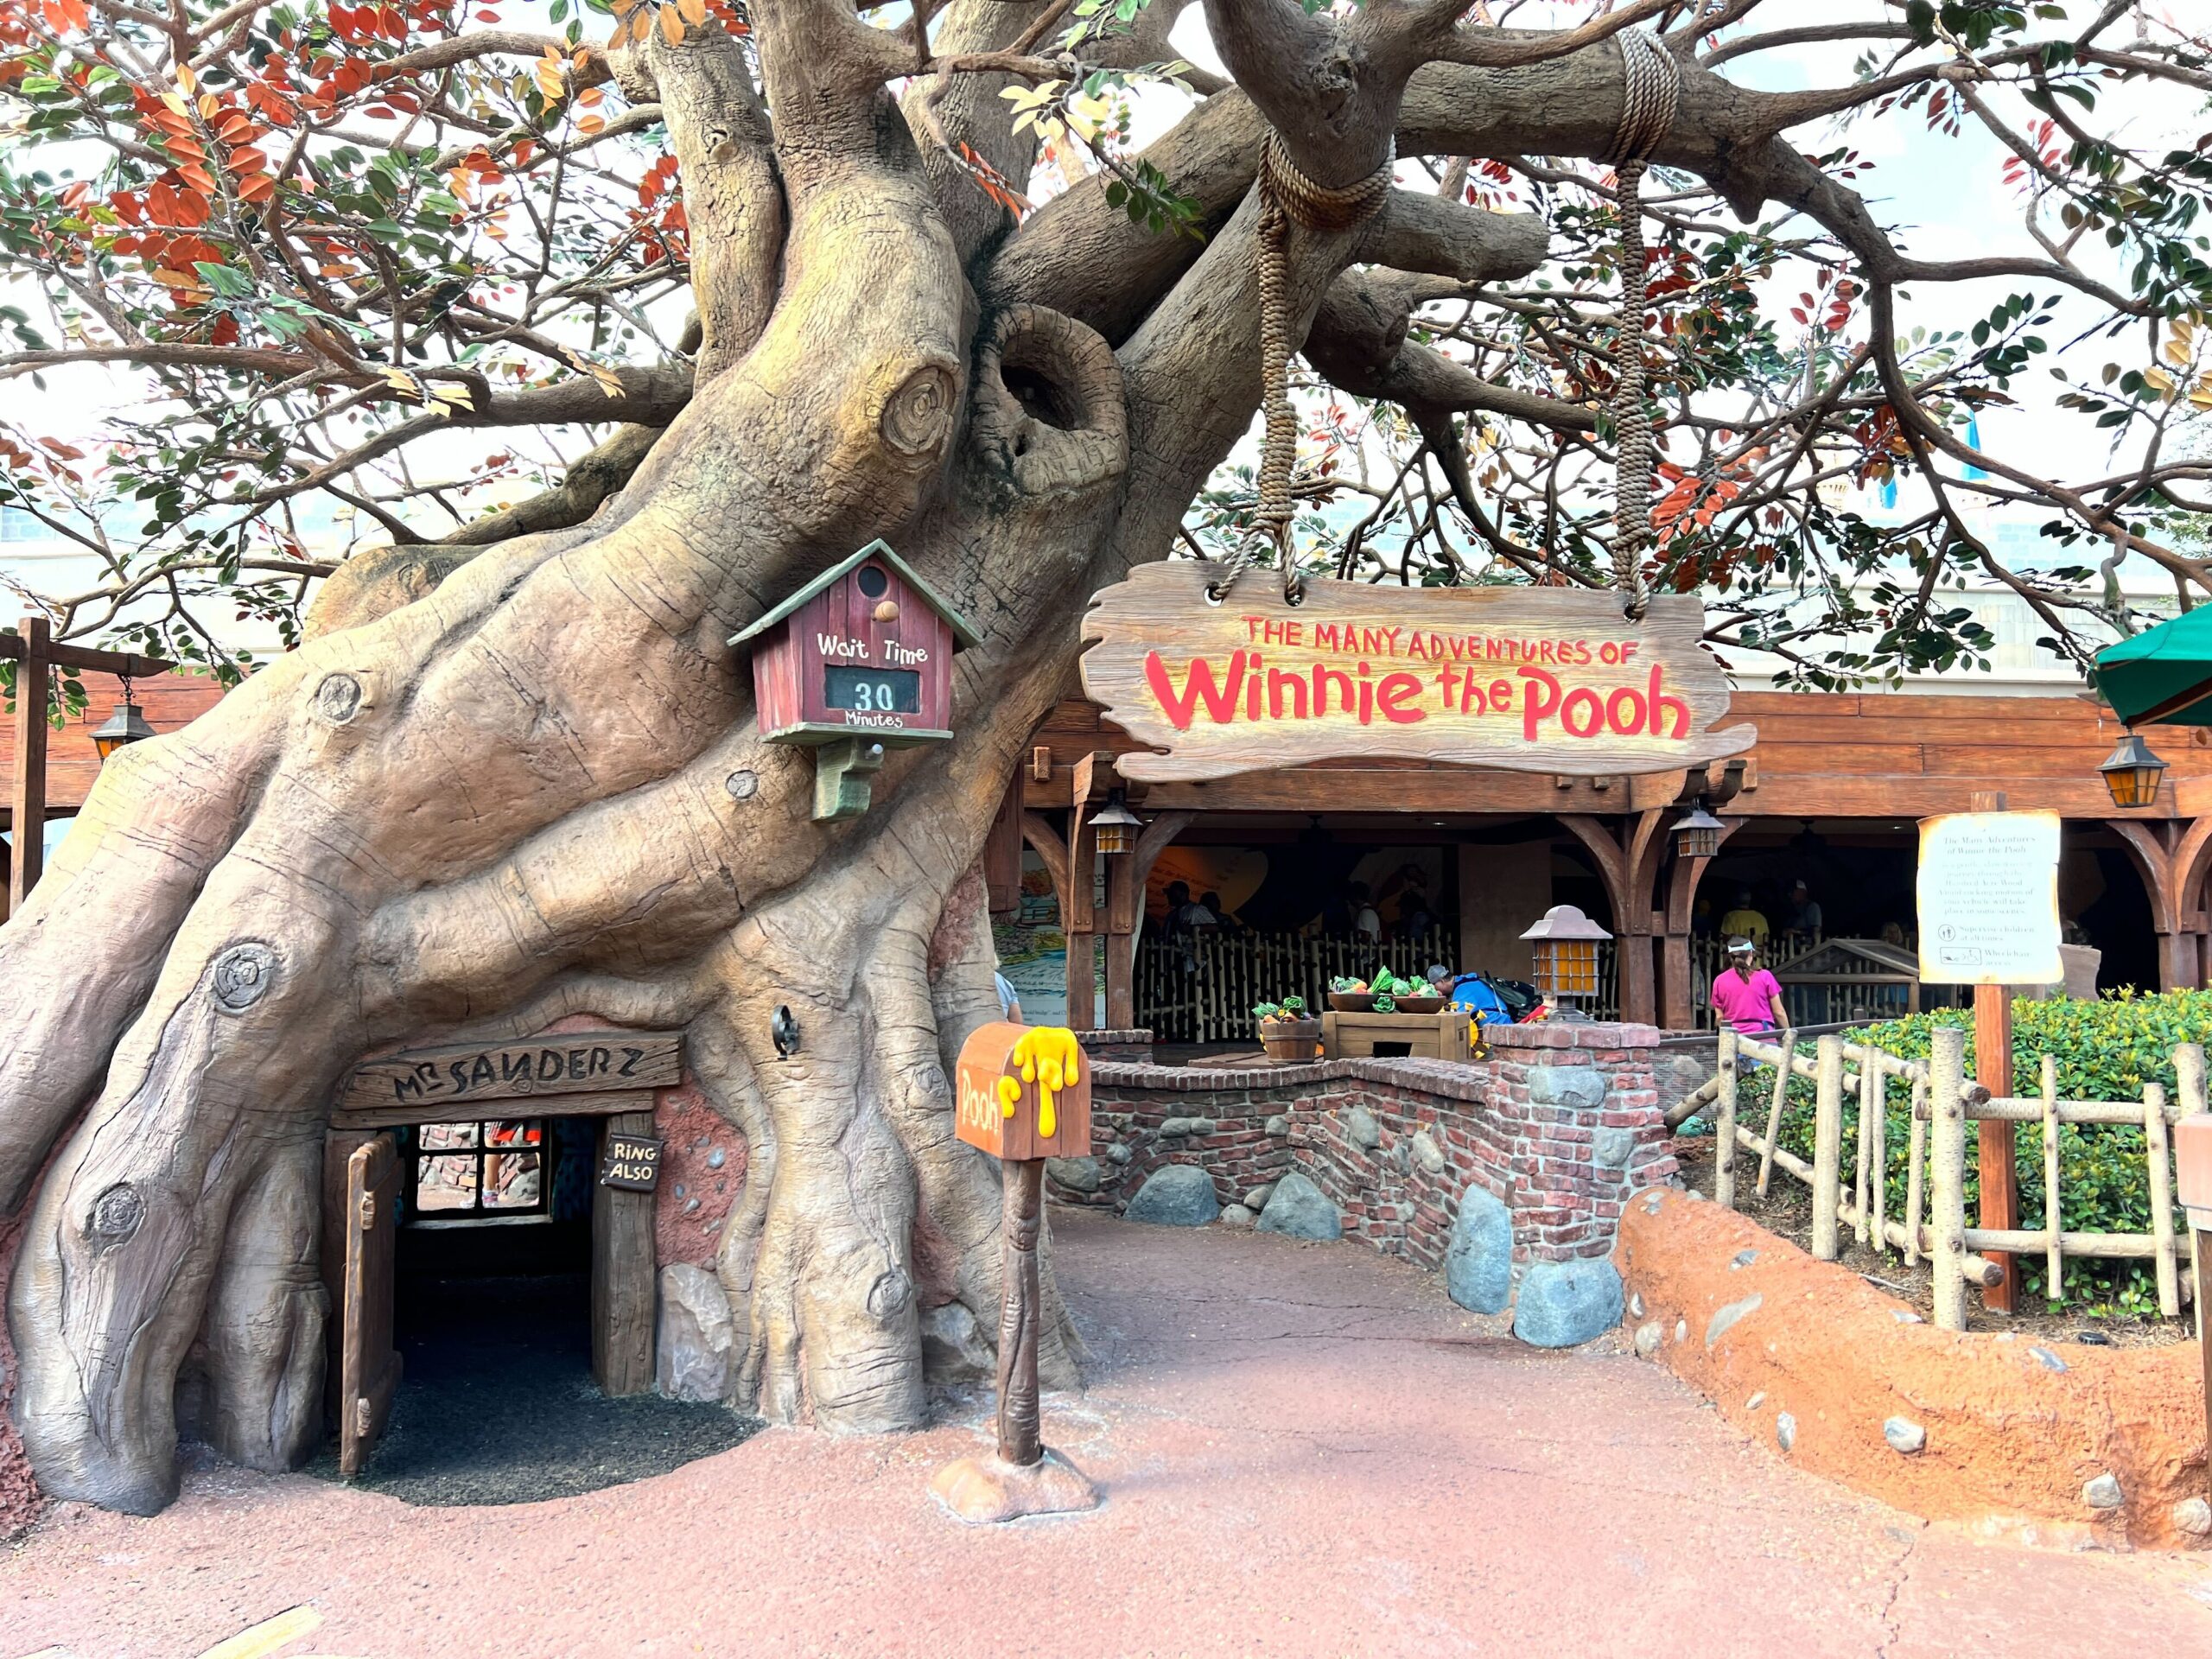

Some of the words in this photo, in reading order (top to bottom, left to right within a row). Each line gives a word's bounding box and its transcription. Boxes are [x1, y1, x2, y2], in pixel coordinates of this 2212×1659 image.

[817, 632, 869, 659] Wait
[883, 639, 928, 664] Time
[1241, 614, 1303, 646] THE
[1314, 622, 1402, 658] MANY
[1408, 631, 1593, 665] ADVENTURES
[1599, 641, 1640, 665] OF
[855, 682, 894, 711] 30
[1144, 649, 1427, 731] Winnie
[1435, 658, 1512, 716] the
[1516, 664, 1691, 743] Pooh
[844, 710, 904, 728] Minutes
[449, 1046, 645, 1095] SANDERZ
[962, 1068, 1000, 1133] Pooh
[608, 1163, 653, 1181] ALSO
